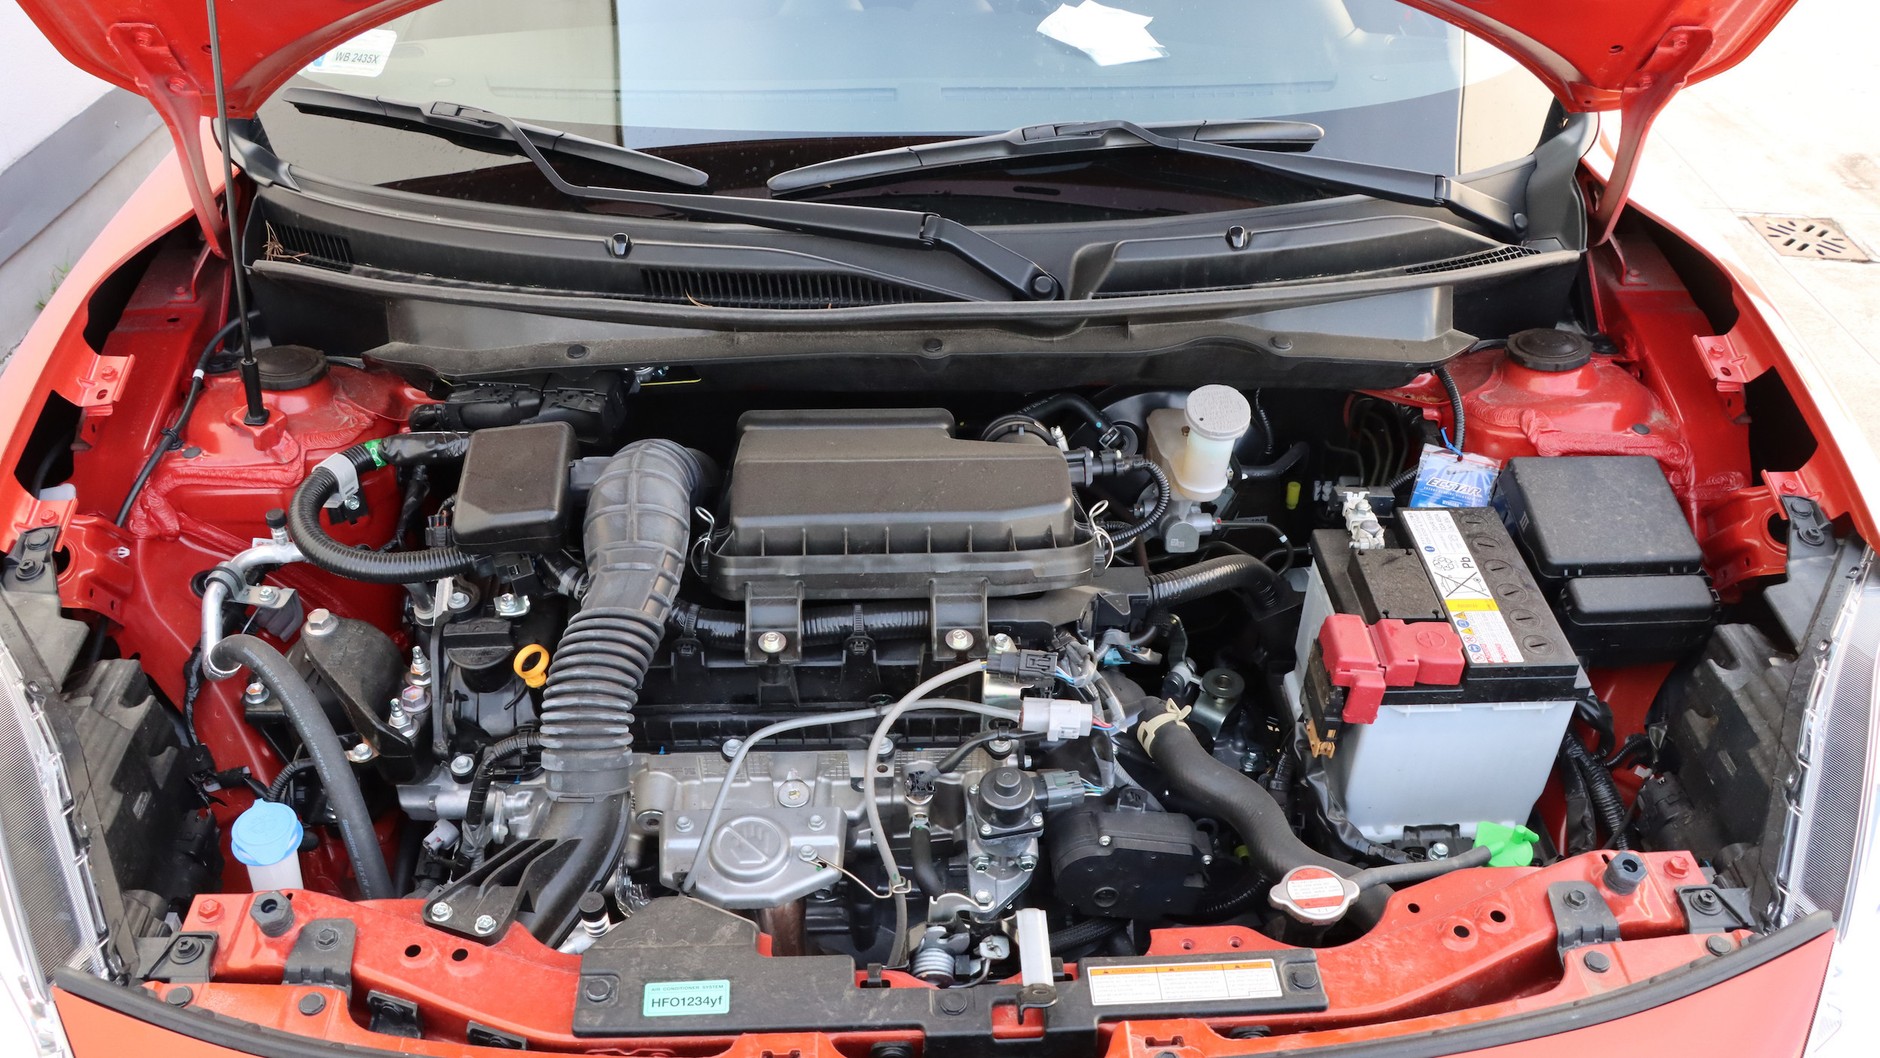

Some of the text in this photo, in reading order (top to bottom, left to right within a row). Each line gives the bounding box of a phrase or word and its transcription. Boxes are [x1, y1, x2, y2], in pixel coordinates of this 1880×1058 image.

[335, 51, 380, 64] WB 2435X
[1426, 476, 1483, 497] ECSTAR
[1460, 556, 1474, 569] Pb
